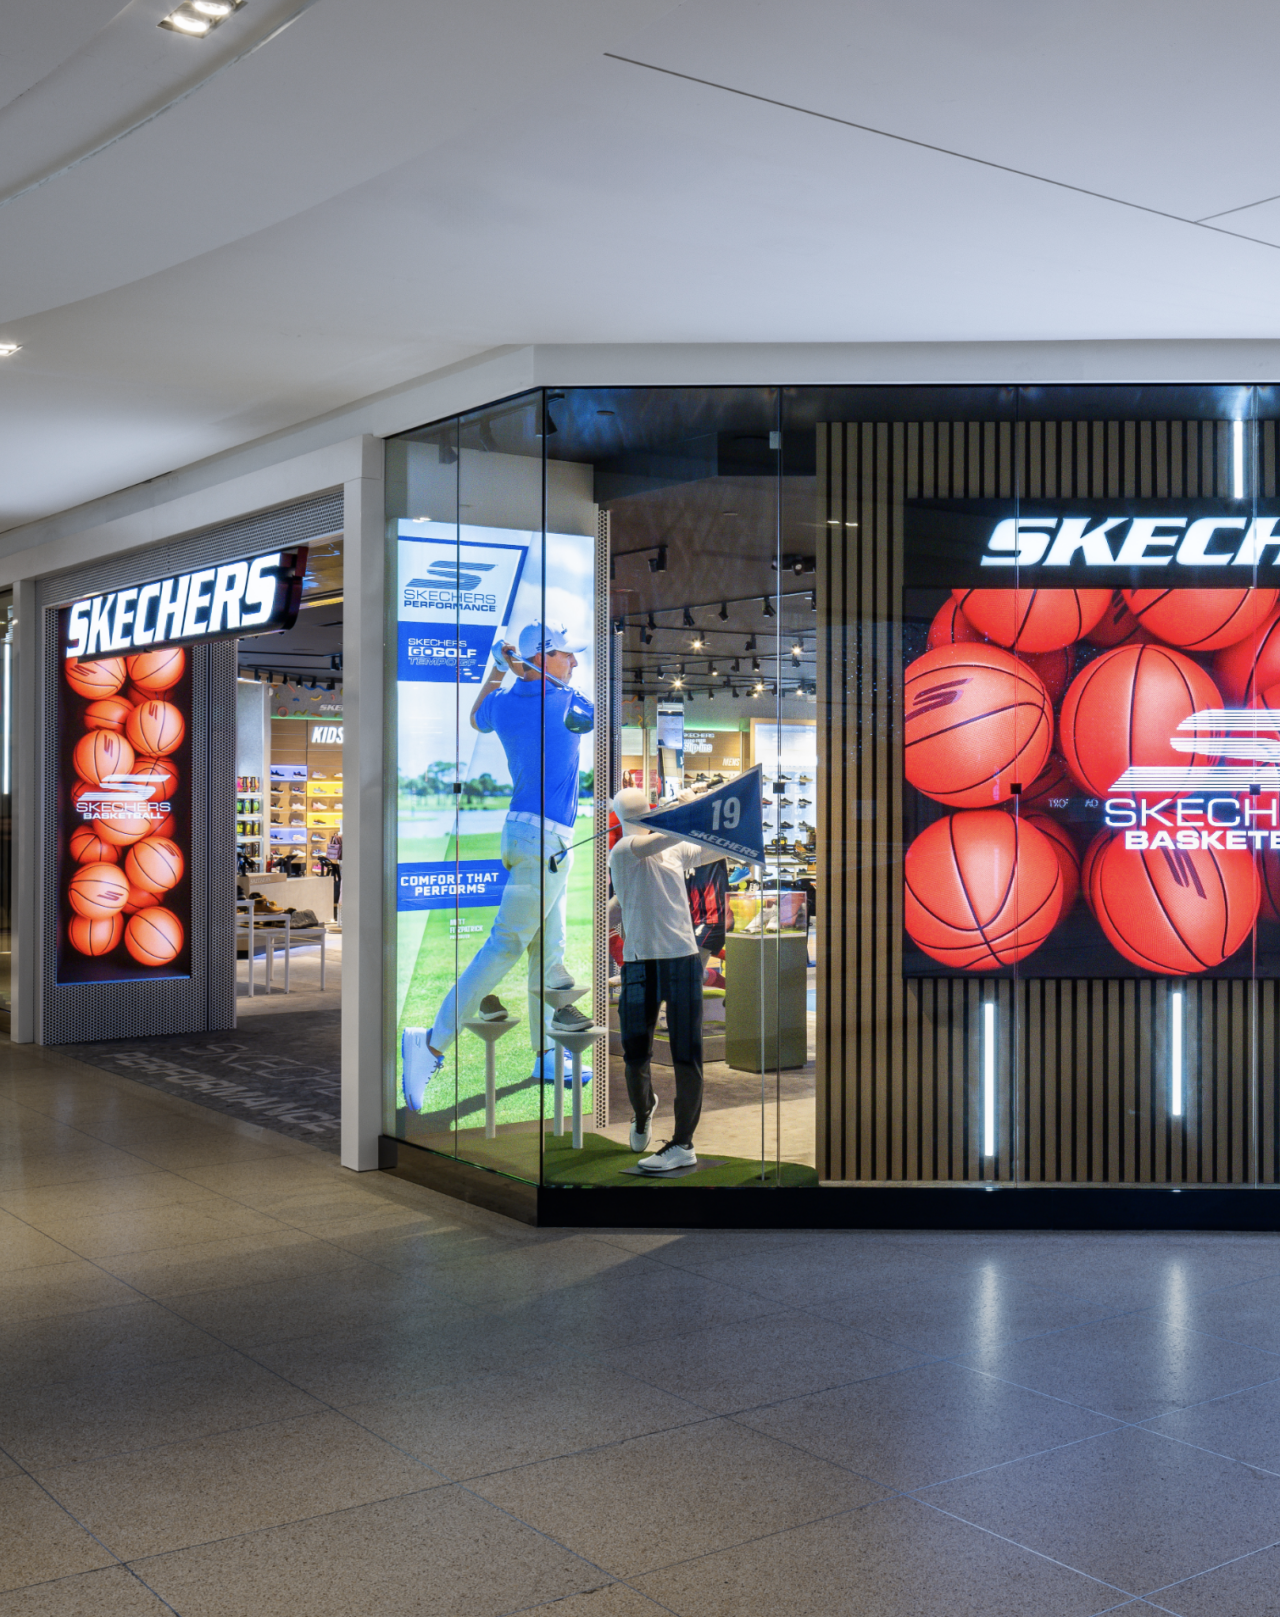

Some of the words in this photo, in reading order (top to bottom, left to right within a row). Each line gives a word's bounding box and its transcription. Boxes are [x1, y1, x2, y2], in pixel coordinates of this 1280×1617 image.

[403, 588, 496, 604] SKECHERS
[65, 552, 282, 659] SKECHERS
[404, 600, 497, 612] PERFORMANCE
[311, 726, 343, 744] KIDS
[76, 801, 171, 813] SKECHERS
[712, 797, 741, 831] 19
[83, 812, 164, 820] BASKETBALL
[688, 829, 760, 858] SKECHERS
[400, 874, 463, 886] COMFORT
[466, 872, 499, 883] THAT
[415, 884, 486, 896] PERFORMS
[180, 1043, 342, 1098] SKECH
